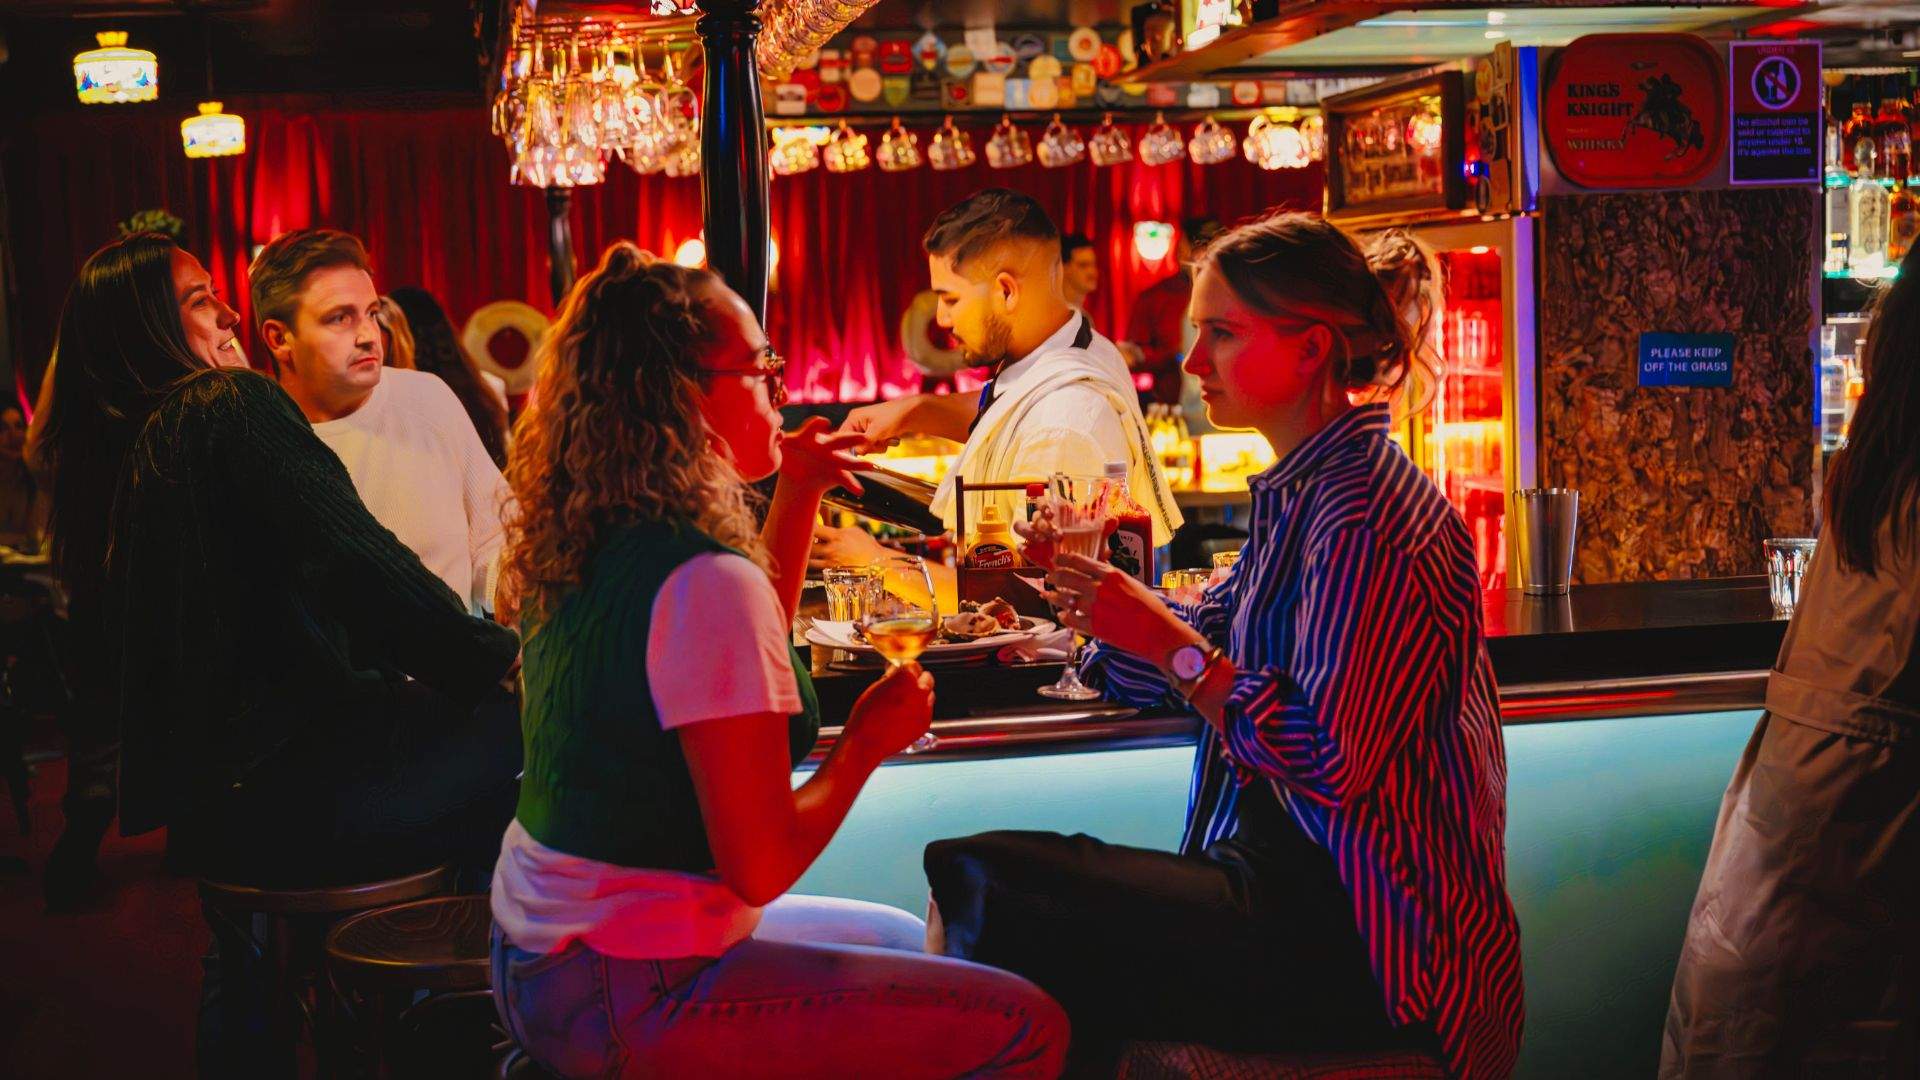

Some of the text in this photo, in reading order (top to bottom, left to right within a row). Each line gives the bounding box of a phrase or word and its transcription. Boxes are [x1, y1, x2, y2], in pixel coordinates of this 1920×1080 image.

[1567, 83, 1621, 97] KING'S
[1567, 102, 1633, 116] KNIGHT
[1567, 139, 1626, 151] WHISKY
[1650, 347, 1722, 358] PLEASE KEEP
[1644, 361, 1728, 373] OFF THE GRASS
[978, 554, 1012, 568] French's
